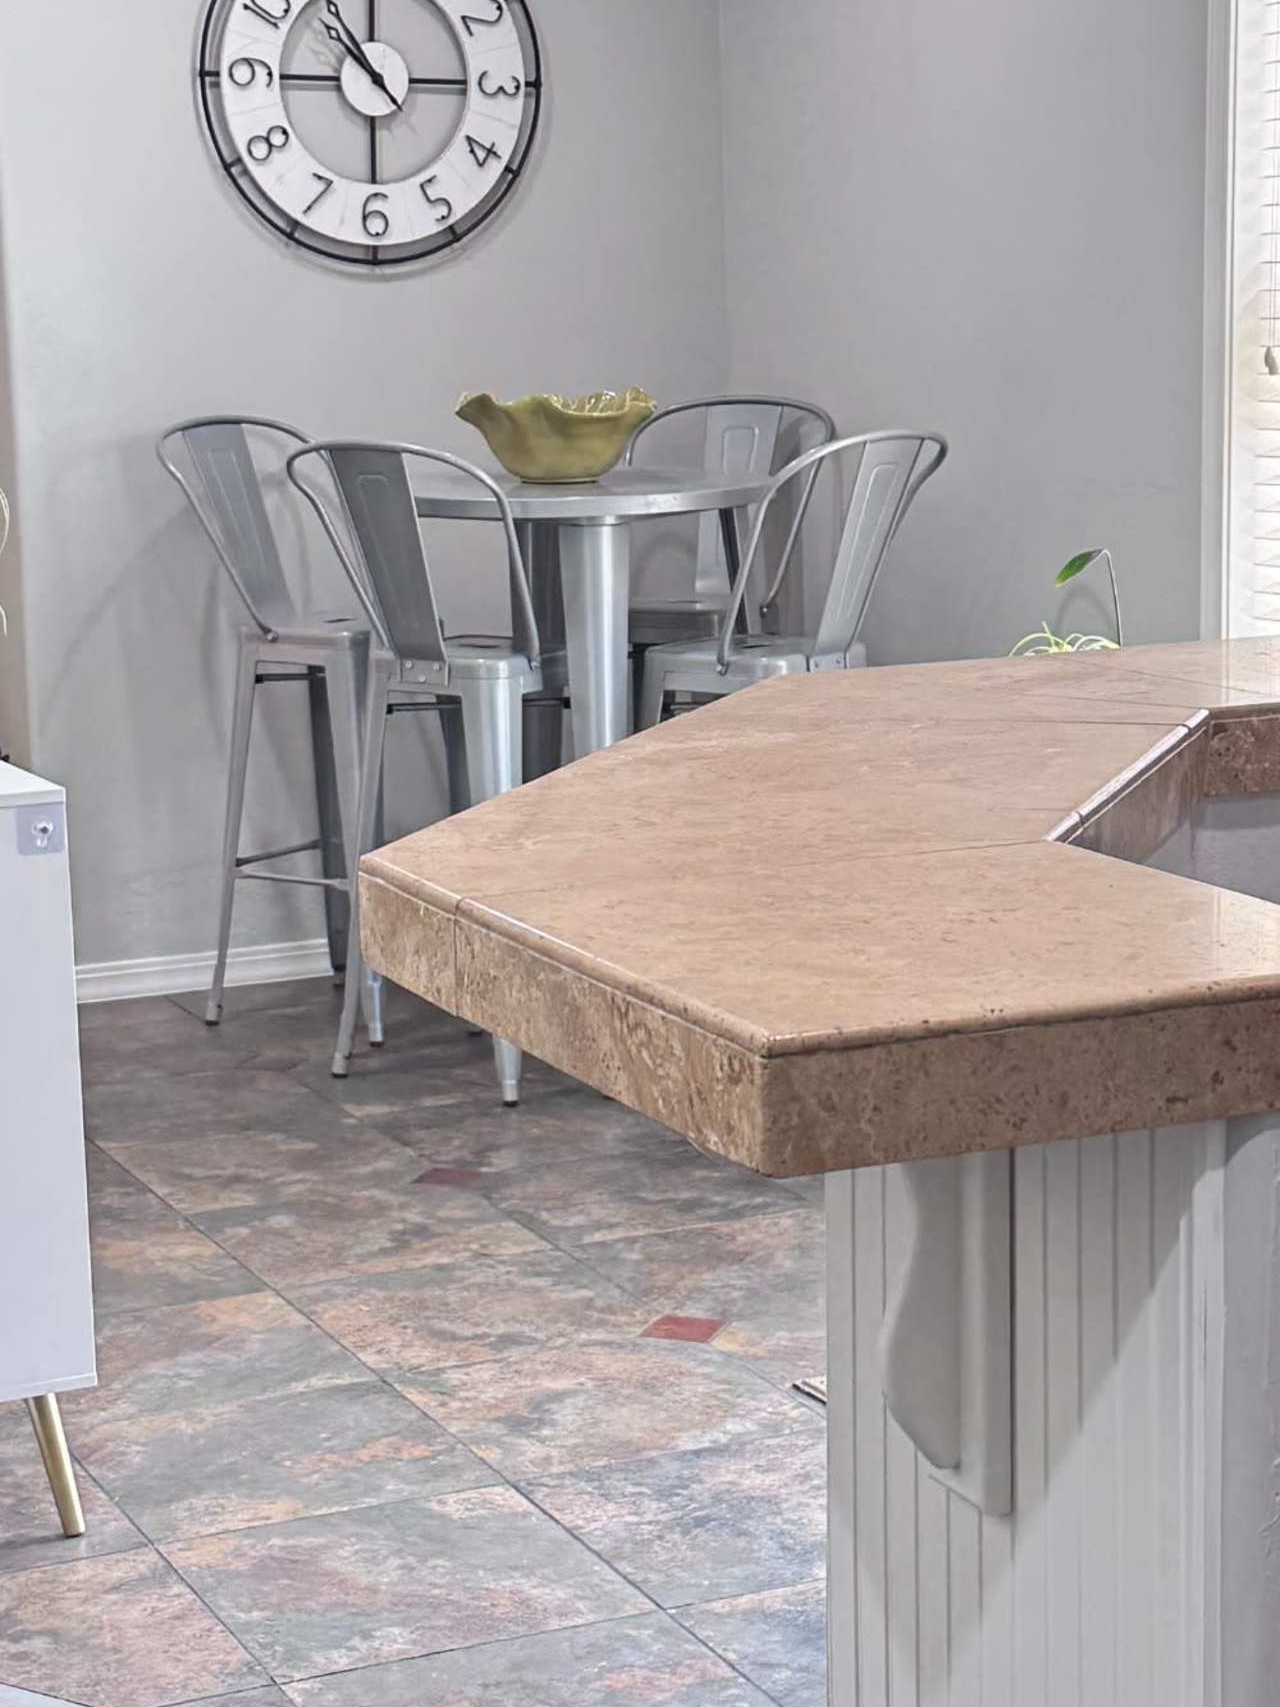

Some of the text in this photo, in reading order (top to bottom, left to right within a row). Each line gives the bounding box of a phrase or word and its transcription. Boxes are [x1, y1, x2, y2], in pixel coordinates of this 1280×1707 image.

[228, 57, 273, 88] 9
[478, 70, 520, 97] 3
[247, 125, 289, 161] 8
[465, 134, 502, 167] 4
[303, 172, 334, 215] 7
[420, 175, 453, 222] 5
[362, 192, 389, 237] 6
